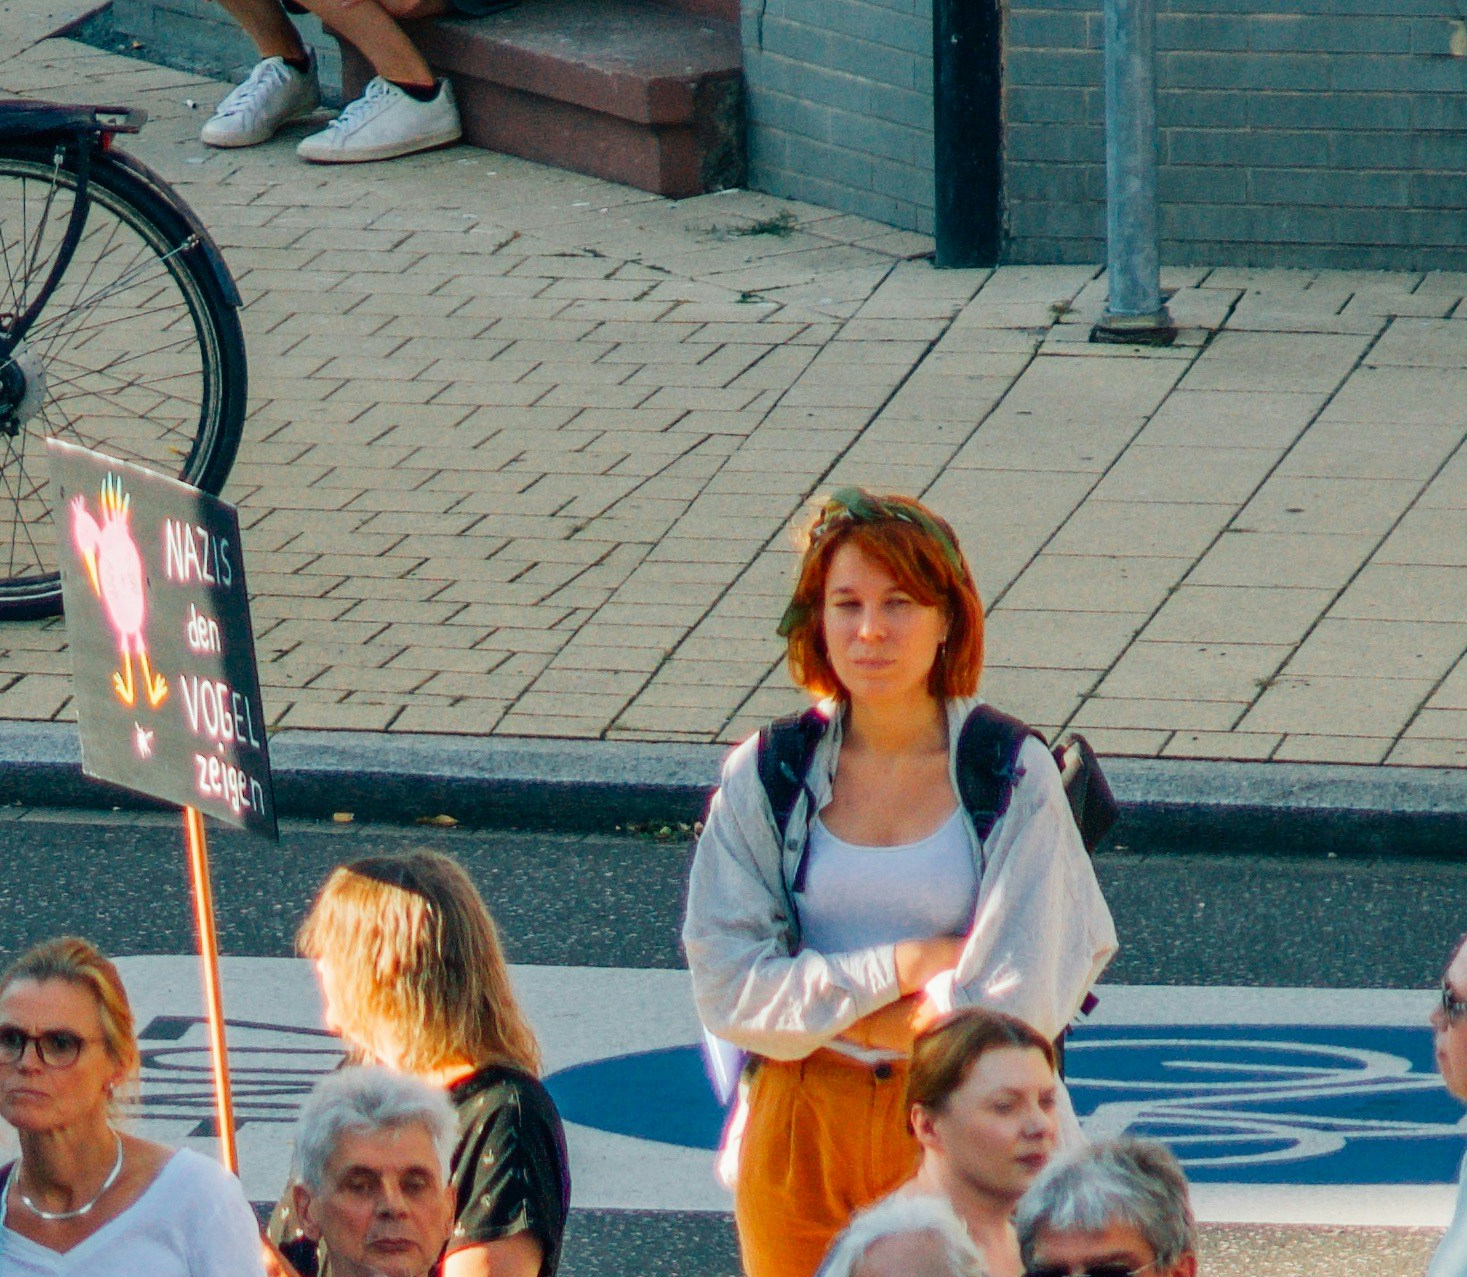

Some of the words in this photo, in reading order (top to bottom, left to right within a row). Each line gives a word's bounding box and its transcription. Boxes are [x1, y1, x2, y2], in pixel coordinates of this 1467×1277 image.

[165, 518, 233, 586] NAZIS
[187, 603, 221, 653] den
[180, 675, 260, 749] VOGEL
[195, 743, 266, 816] zeigen
